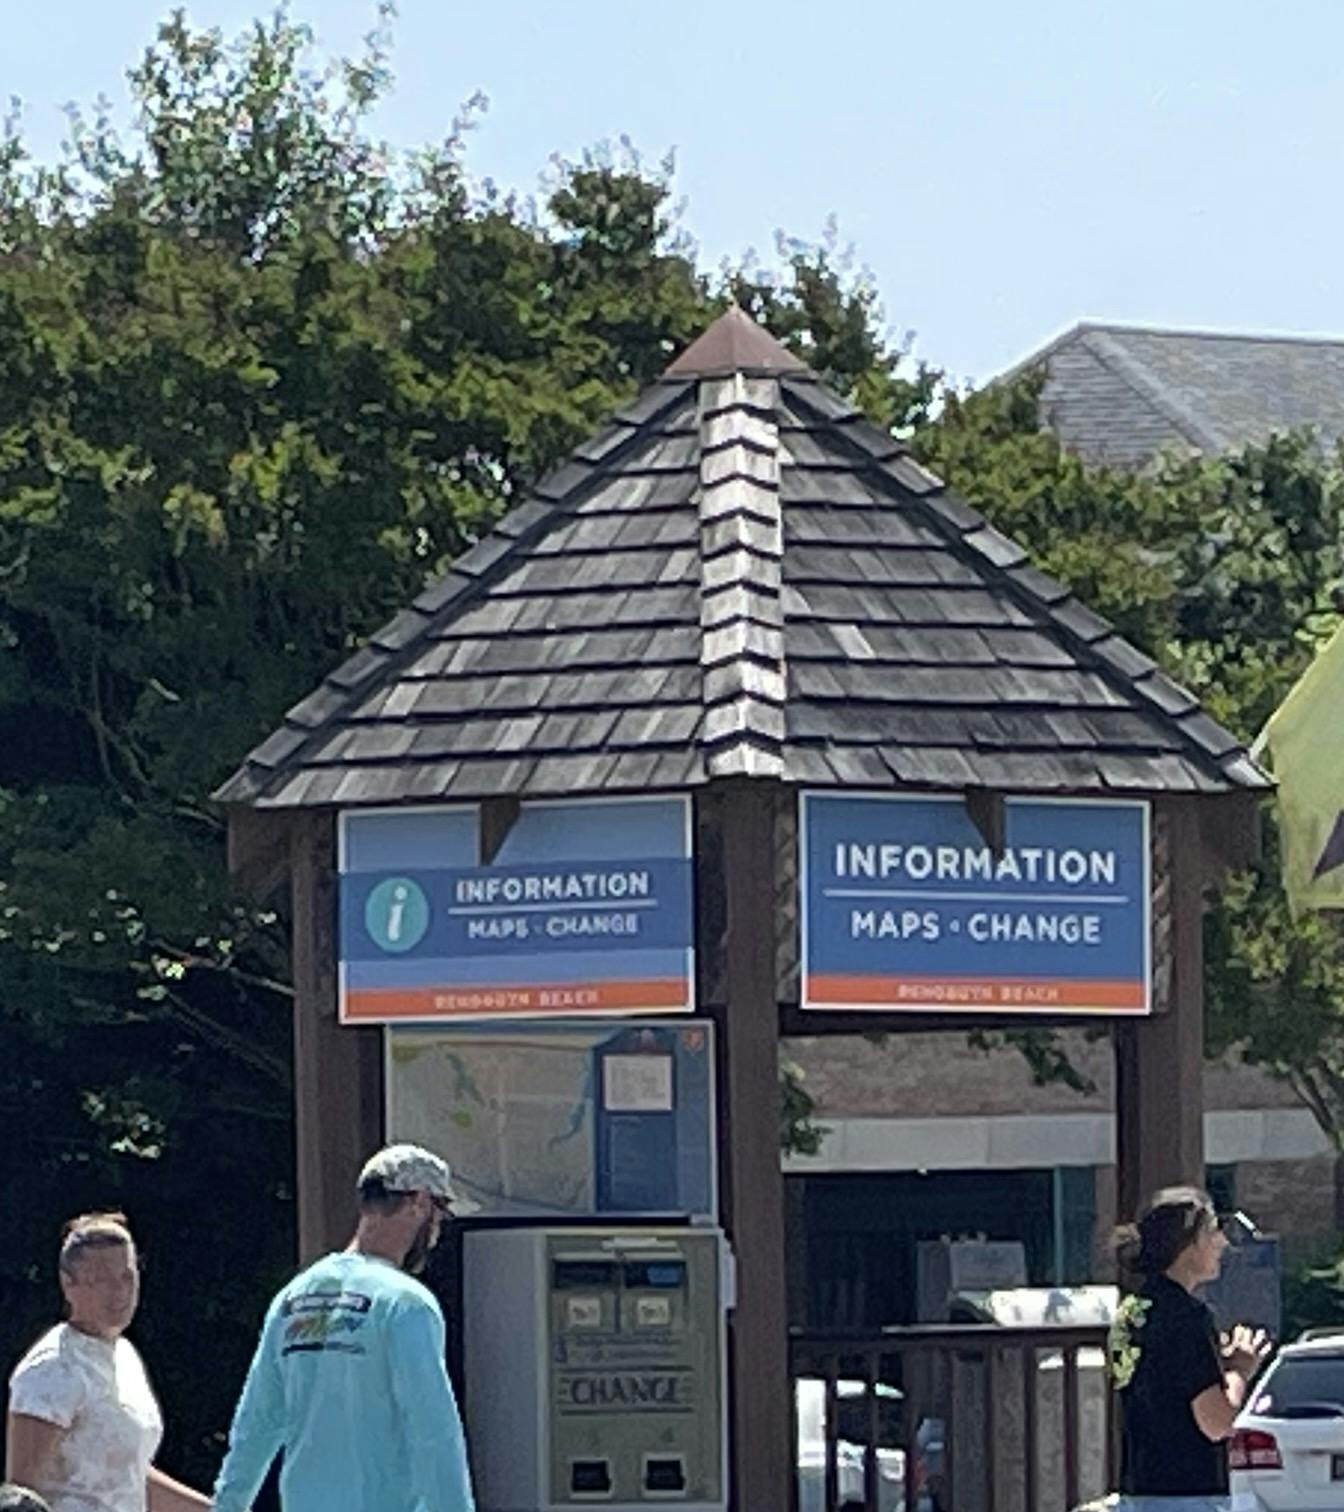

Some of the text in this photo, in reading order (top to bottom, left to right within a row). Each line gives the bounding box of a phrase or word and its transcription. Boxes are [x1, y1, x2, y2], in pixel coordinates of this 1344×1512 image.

[835, 843, 1116, 884] INFORMATION
[457, 872, 648, 902] INFORMATION
[468, 913, 638, 939] MAPS CHANGE
[851, 910, 1102, 945] MAPS CHANGE
